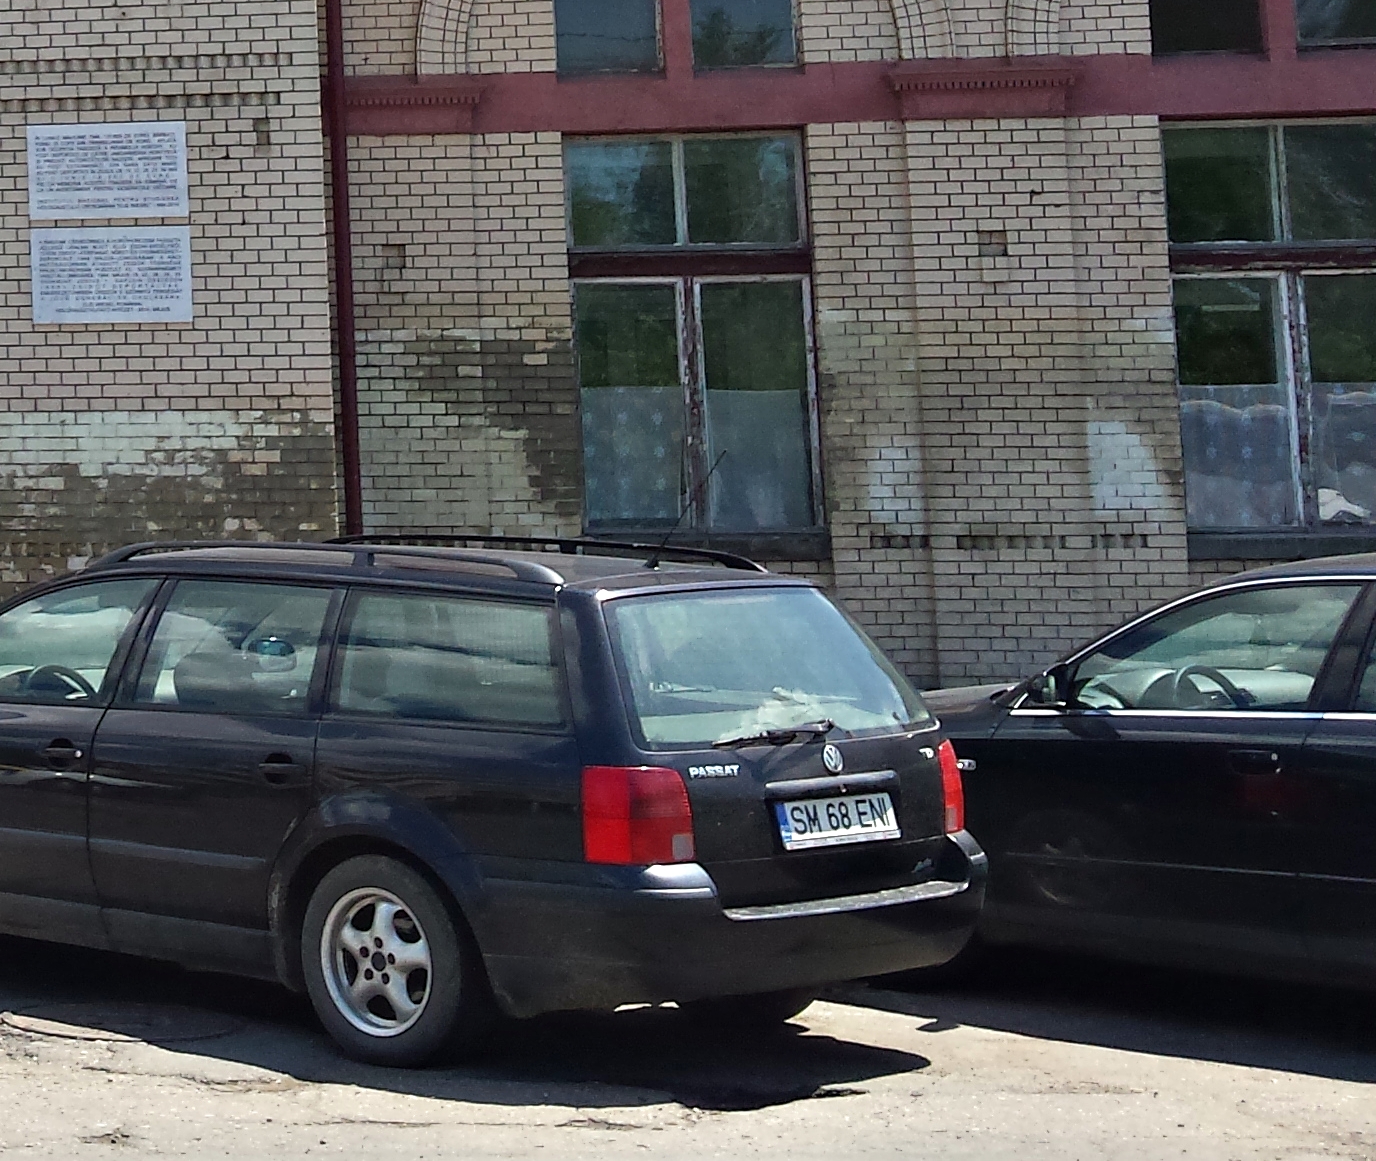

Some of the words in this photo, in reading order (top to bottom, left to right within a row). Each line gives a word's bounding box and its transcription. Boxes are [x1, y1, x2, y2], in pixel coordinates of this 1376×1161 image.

[689, 764, 741, 779] PASSAT
[791, 804, 822, 835] SM
[826, 802, 852, 831] 68
[855, 797, 891, 828] ENI
